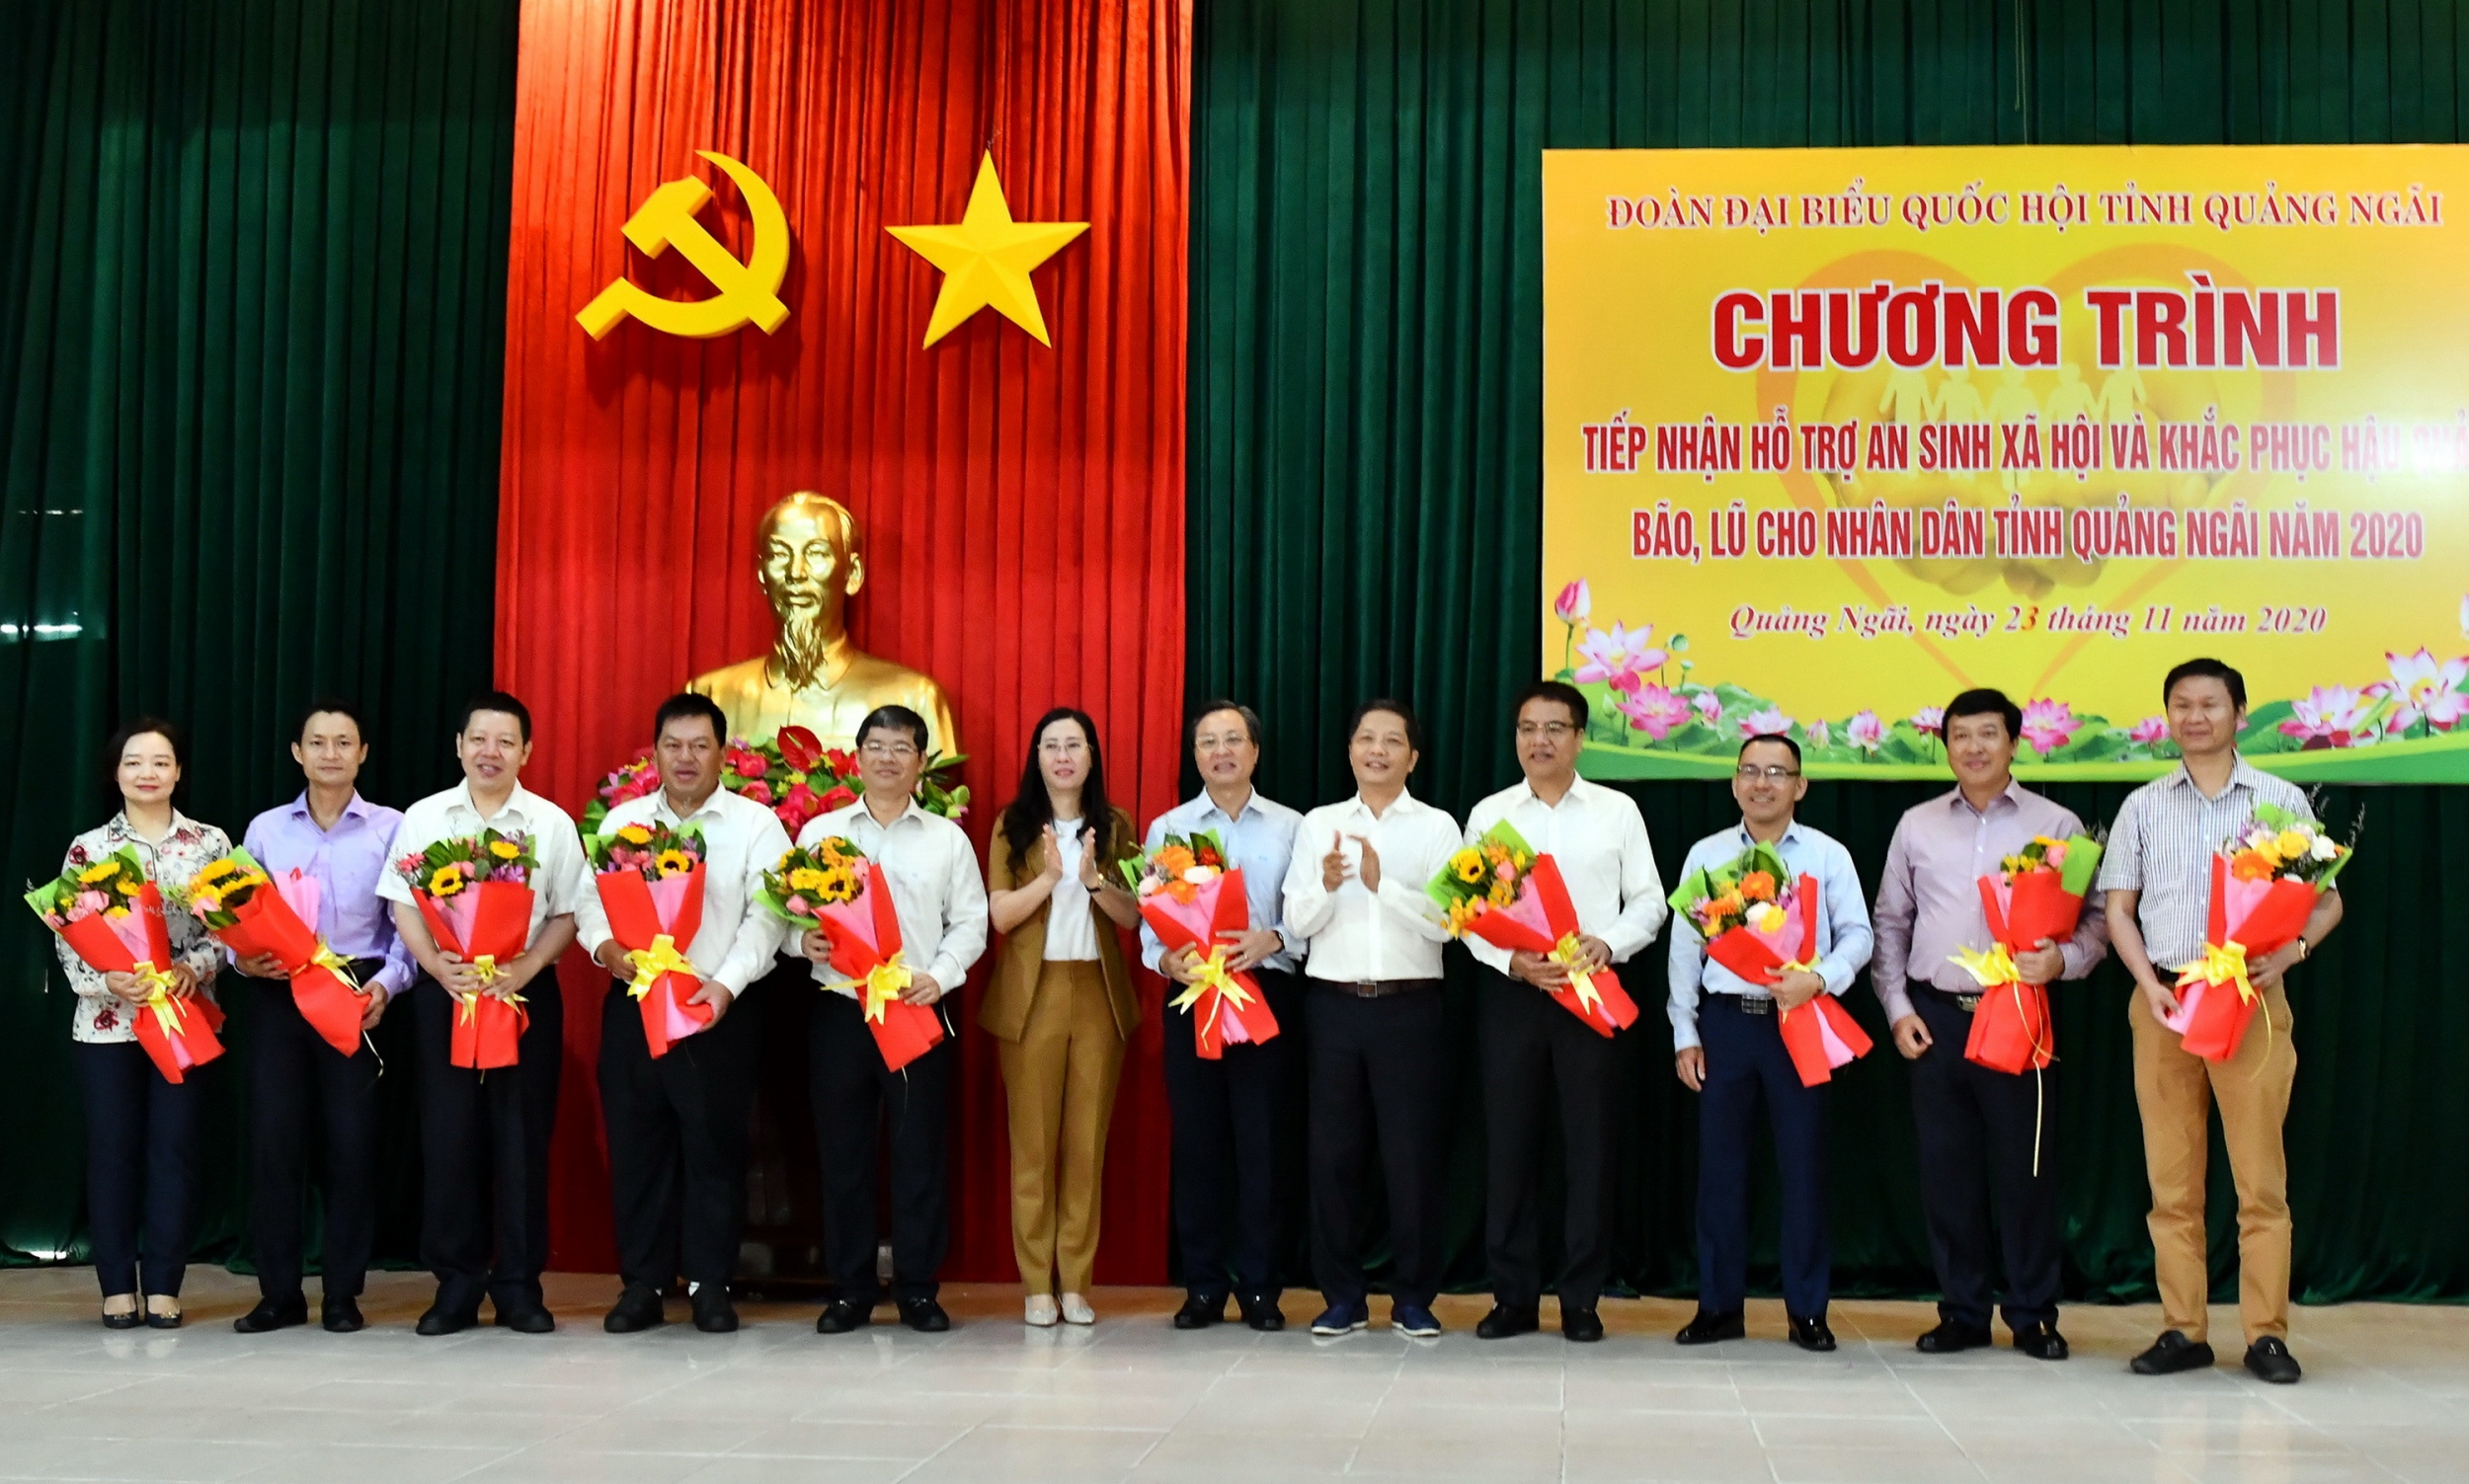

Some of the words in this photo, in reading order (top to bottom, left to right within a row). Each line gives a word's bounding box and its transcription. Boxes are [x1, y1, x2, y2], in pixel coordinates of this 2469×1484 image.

[1608, 188, 1712, 228] ĐOÀN
[1723, 195, 1789, 234] ĐẠI
[1800, 178, 1890, 226] BIỂU
[1902, 181, 2008, 231] QUỐC
[2021, 185, 2089, 232] HỘI
[2100, 182, 2192, 225] TỈNH
[2203, 182, 2338, 231] QUẢNG
[2349, 185, 2443, 226] NGÃI
[1712, 280, 2060, 371] CHƯƠNG
[2086, 271, 2341, 370] TRÌNH
[1582, 409, 1647, 472] TIẾP
[1656, 415, 1741, 482] NHẬN
[1751, 406, 1792, 472] HỖ
[1800, 419, 1858, 482] TRỢ
[1866, 423, 1908, 471] AN
[1918, 423, 1991, 471] SINH
[2001, 413, 2041, 470] XÃ
[2050, 413, 2102, 481] HỘI
[2111, 413, 2150, 470] VÀ
[2159, 405, 2241, 471] KHẮC
[2250, 423, 2330, 482] PHỤC
[2341, 414, 2401, 483] HẬU
[1633, 501, 1701, 564] BÃO,
[1710, 501, 1746, 558] LŨ
[1756, 509, 1817, 558] CHO
[1826, 500, 1912, 559] NHÂN
[1920, 500, 1984, 559] DÂN
[1993, 494, 2062, 558] TỈNH
[2072, 495, 2177, 564] QUẢNG
[2186, 501, 2259, 558] NGÃI
[2270, 502, 2340, 558] NĂM
[2350, 510, 2424, 559] 2020
[1730, 605, 1828, 639] Quảng
[1835, 604, 1915, 639] Ngãi,
[1925, 605, 1995, 639] ngày
[2004, 604, 2038, 632] 23
[2047, 605, 2131, 639] tháng
[2143, 605, 2172, 632] 11
[2183, 605, 2247, 633] năm
[2257, 605, 2327, 633] 2020
